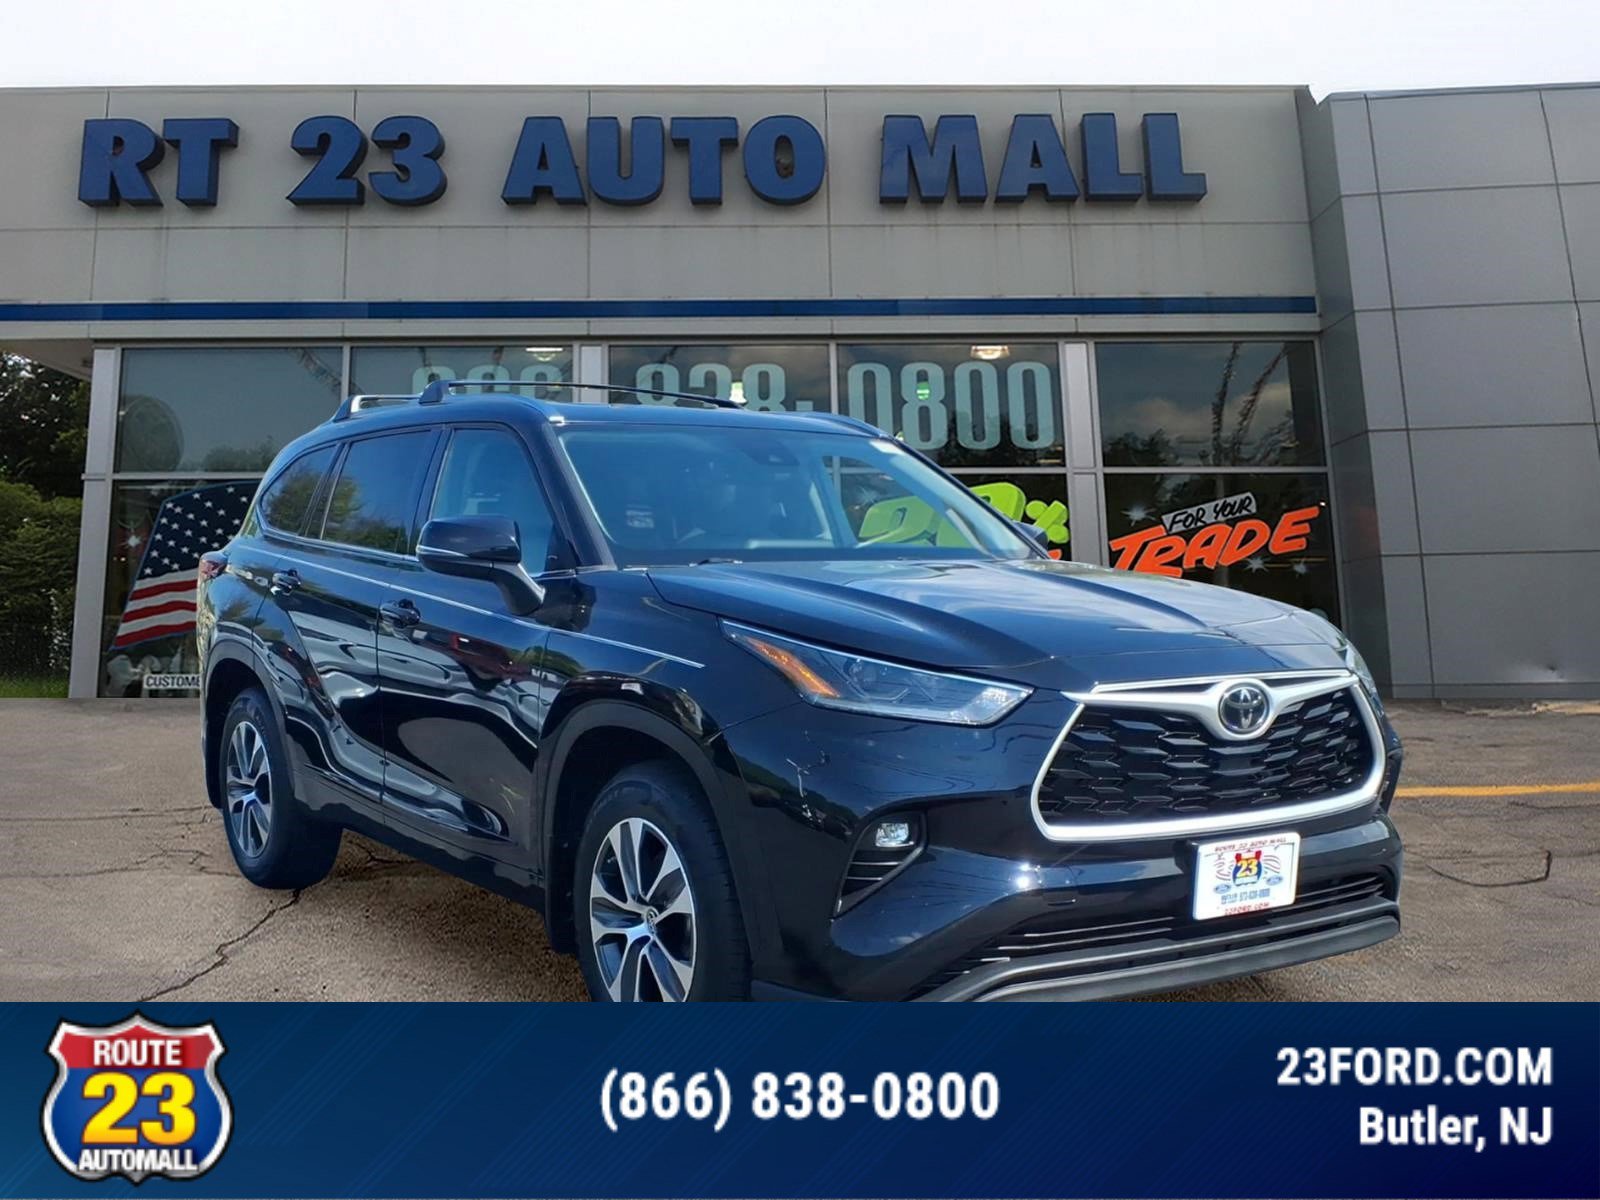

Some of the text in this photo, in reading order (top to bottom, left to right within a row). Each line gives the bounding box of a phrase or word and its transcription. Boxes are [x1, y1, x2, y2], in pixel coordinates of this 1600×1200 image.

[78, 112, 1207, 206] RT 23 AUTO MALL
[1168, 496, 1251, 530] FOR YOUR
[1109, 506, 1320, 578] TRADE
[1236, 858, 1259, 878] 23
